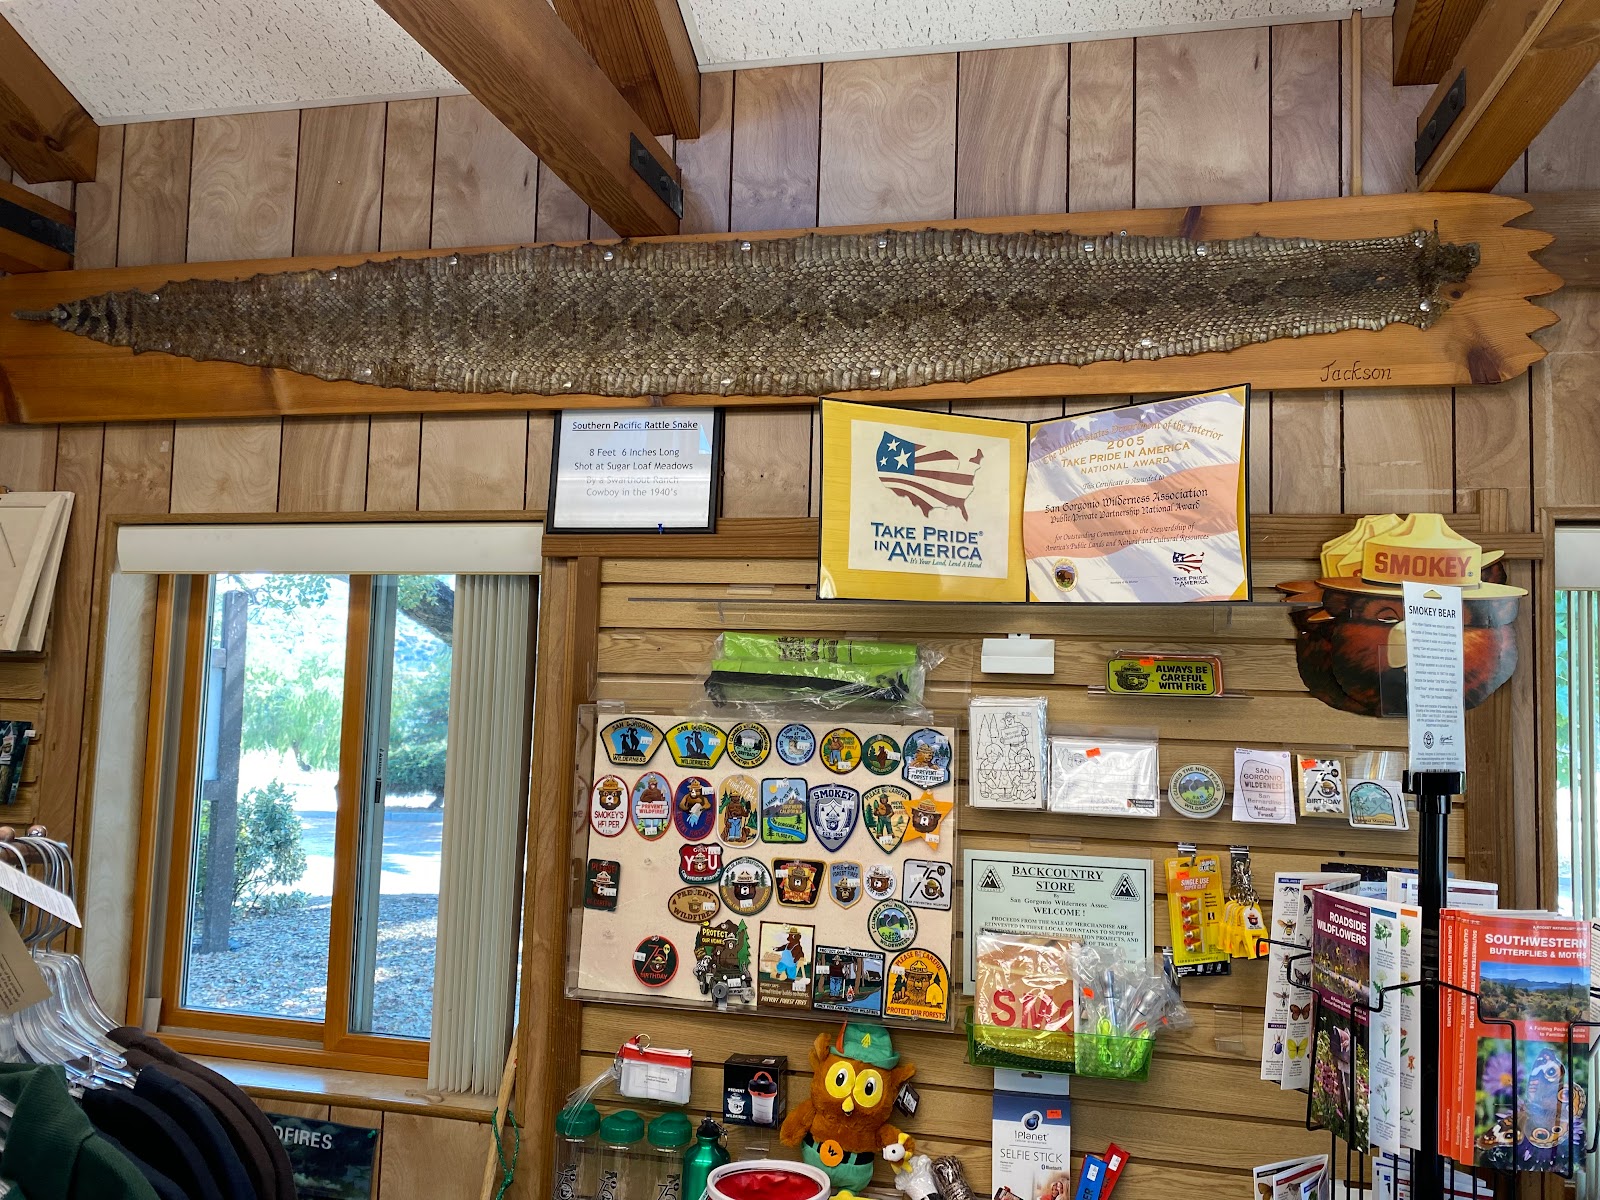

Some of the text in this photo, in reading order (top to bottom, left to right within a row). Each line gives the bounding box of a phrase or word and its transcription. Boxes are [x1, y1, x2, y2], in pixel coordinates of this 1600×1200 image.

[1320, 360, 1391, 382] Jackson
[572, 421, 698, 430] Southern Pacific Rattle Snake
[1043, 420, 1224, 464] The United States Department of the Interior
[1107, 436, 1145, 450] 2005
[660, 449, 679, 457] Long
[1061, 457, 1086, 468] TAKE
[1089, 452, 1121, 464] PRIDE
[1124, 450, 1135, 459] IN
[574, 462, 592, 470] Shot
[607, 462, 630, 471] Sugar
[633, 462, 651, 470] Loaf
[654, 462, 693, 470] Meadows
[1081, 456, 1169, 475] NATIONAL AWARD
[587, 476, 596, 485] By
[653, 475, 679, 484] Ranch
[1083, 482, 1093, 491] This
[1094, 477, 1123, 490] Certificate
[1131, 474, 1154, 485] Awarded
[587, 488, 678, 497] Cowboy in the 1940's
[1045, 488, 1208, 514] San Gorgonio Wilderness Association
[1050, 500, 1200, 524] Public/Private Partnership National Award
[871, 522, 915, 539] TAKE
[1063, 530, 1096, 541] Outstanding
[1097, 529, 1131, 539] Commitment
[1150, 524, 1186, 535] Stewardship
[1187, 523, 1195, 531] of
[874, 540, 982, 562] IN AMERICA
[1374, 552, 1472, 578] SMOKEY
[1409, 606, 1456, 618] SMOKEY BEAR
[1156, 665, 1192, 674] ALWAYS
[1161, 674, 1204, 682] CAREFUL
[1159, 682, 1207, 691] WITH FIRE
[612, 721, 654, 732] SAN GORGONIO
[691, 724, 719, 736] GORGONIO
[612, 754, 647, 763] WILDERNESS
[680, 758, 710, 766] WILDERNESS
[814, 789, 854, 800] SMOKEY
[865, 788, 907, 800] PLEASE CAREFUL
[1185, 798, 1218, 810] WILDERNESS
[594, 811, 624, 819] SMOKEY'S
[1012, 866, 1104, 881] BACKCOUNTRY
[1036, 881, 1075, 892] STORE
[1024, 898, 1052, 906] Gorgonio
[1034, 907, 1080, 916] WELCOME
[1330, 912, 1366, 933] ROADSIDE
[703, 928, 728, 938] PROTECT
[1317, 919, 1366, 946] WILDFLOWERS
[880, 938, 910, 947] WILDERNESS
[1485, 934, 1587, 948] SOUTHWESTERN
[1490, 947, 1547, 958] BUTTERFLIES
[1558, 952, 1587, 960] MOTHS
[895, 952, 913, 966] PLEASE
[923, 953, 942, 971] CAREFUL
[923, 1010, 945, 1019] FORESTS
[828, 1146, 837, 1157] W
[1000, 1149, 1063, 1163] SELFIE STICK
